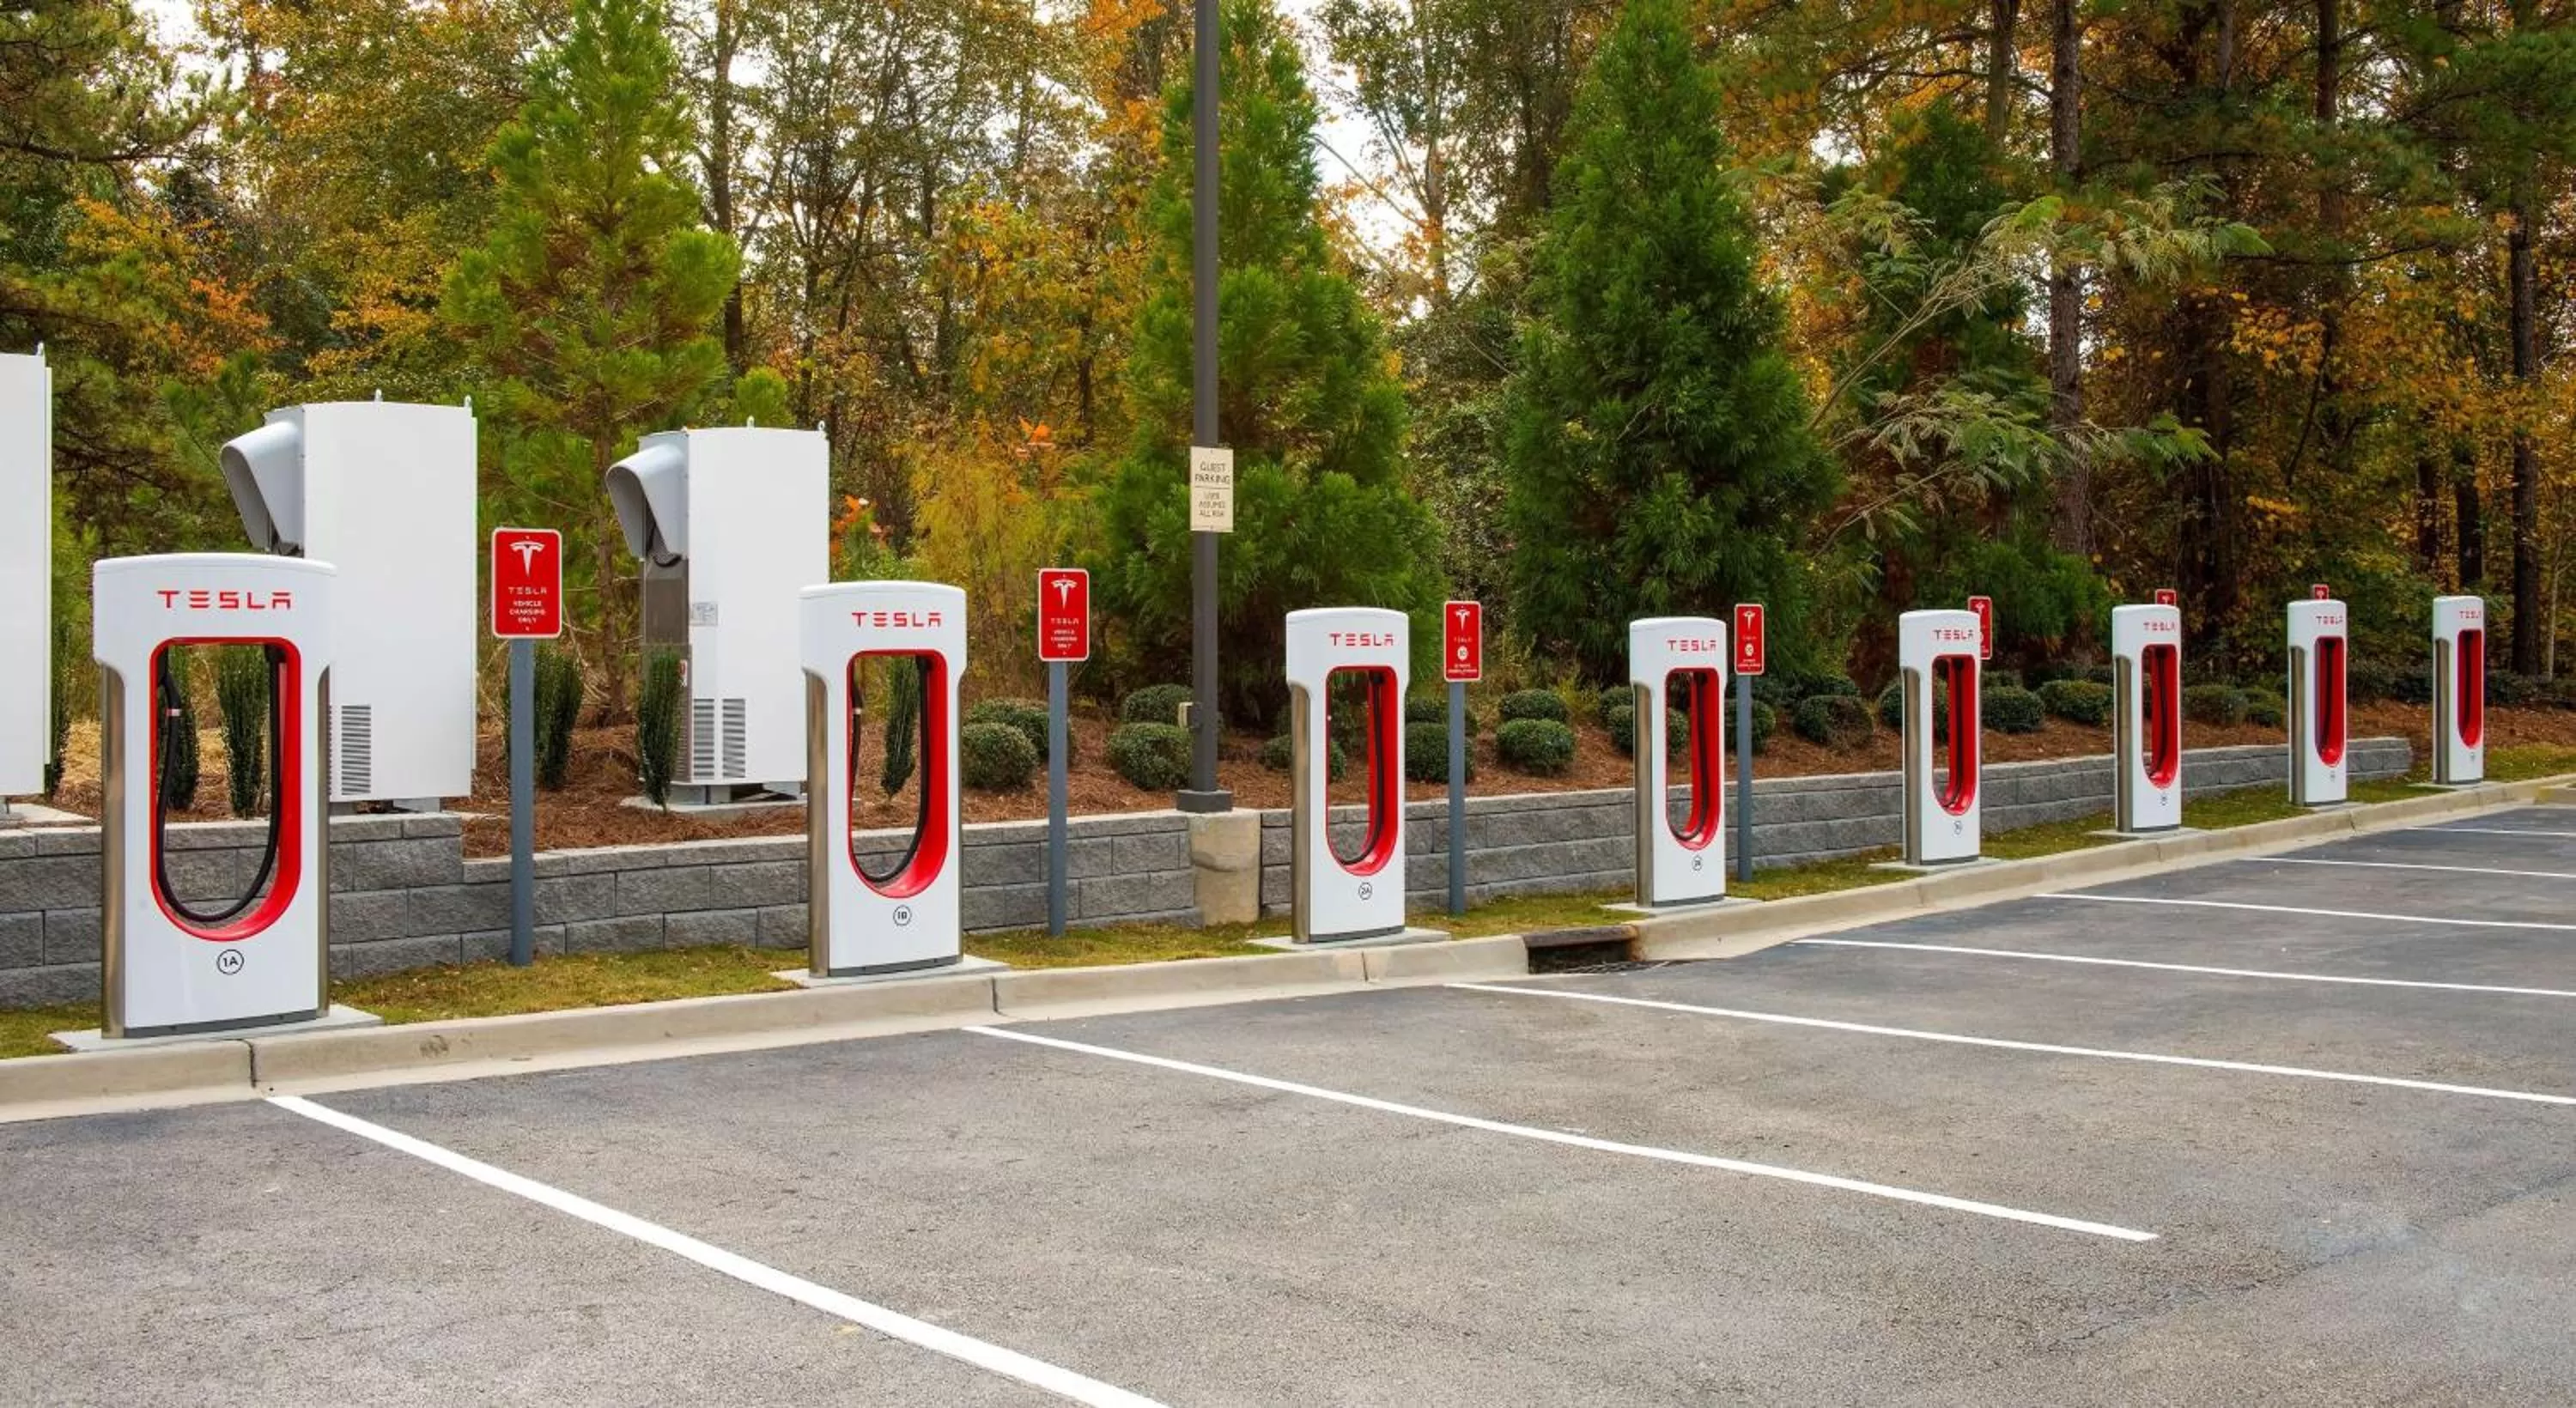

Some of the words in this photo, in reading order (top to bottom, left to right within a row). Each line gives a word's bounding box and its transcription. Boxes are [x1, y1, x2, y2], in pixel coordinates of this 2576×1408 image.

[1200, 462, 1226, 471] GUEST
[1194, 474, 1230, 484] PARKING
[508, 586, 547, 595] TESLA
[156, 590, 291, 610] TESLA
[851, 612, 941, 628] TESLA
[2316, 615, 2343, 625] TESLA
[2142, 622, 2175, 631] TESLA
[1328, 633, 1394, 646] TESLA
[1933, 629, 1974, 640] TESLA
[1667, 640, 1716, 652] TESLA
[222, 956, 240, 968] 1A
